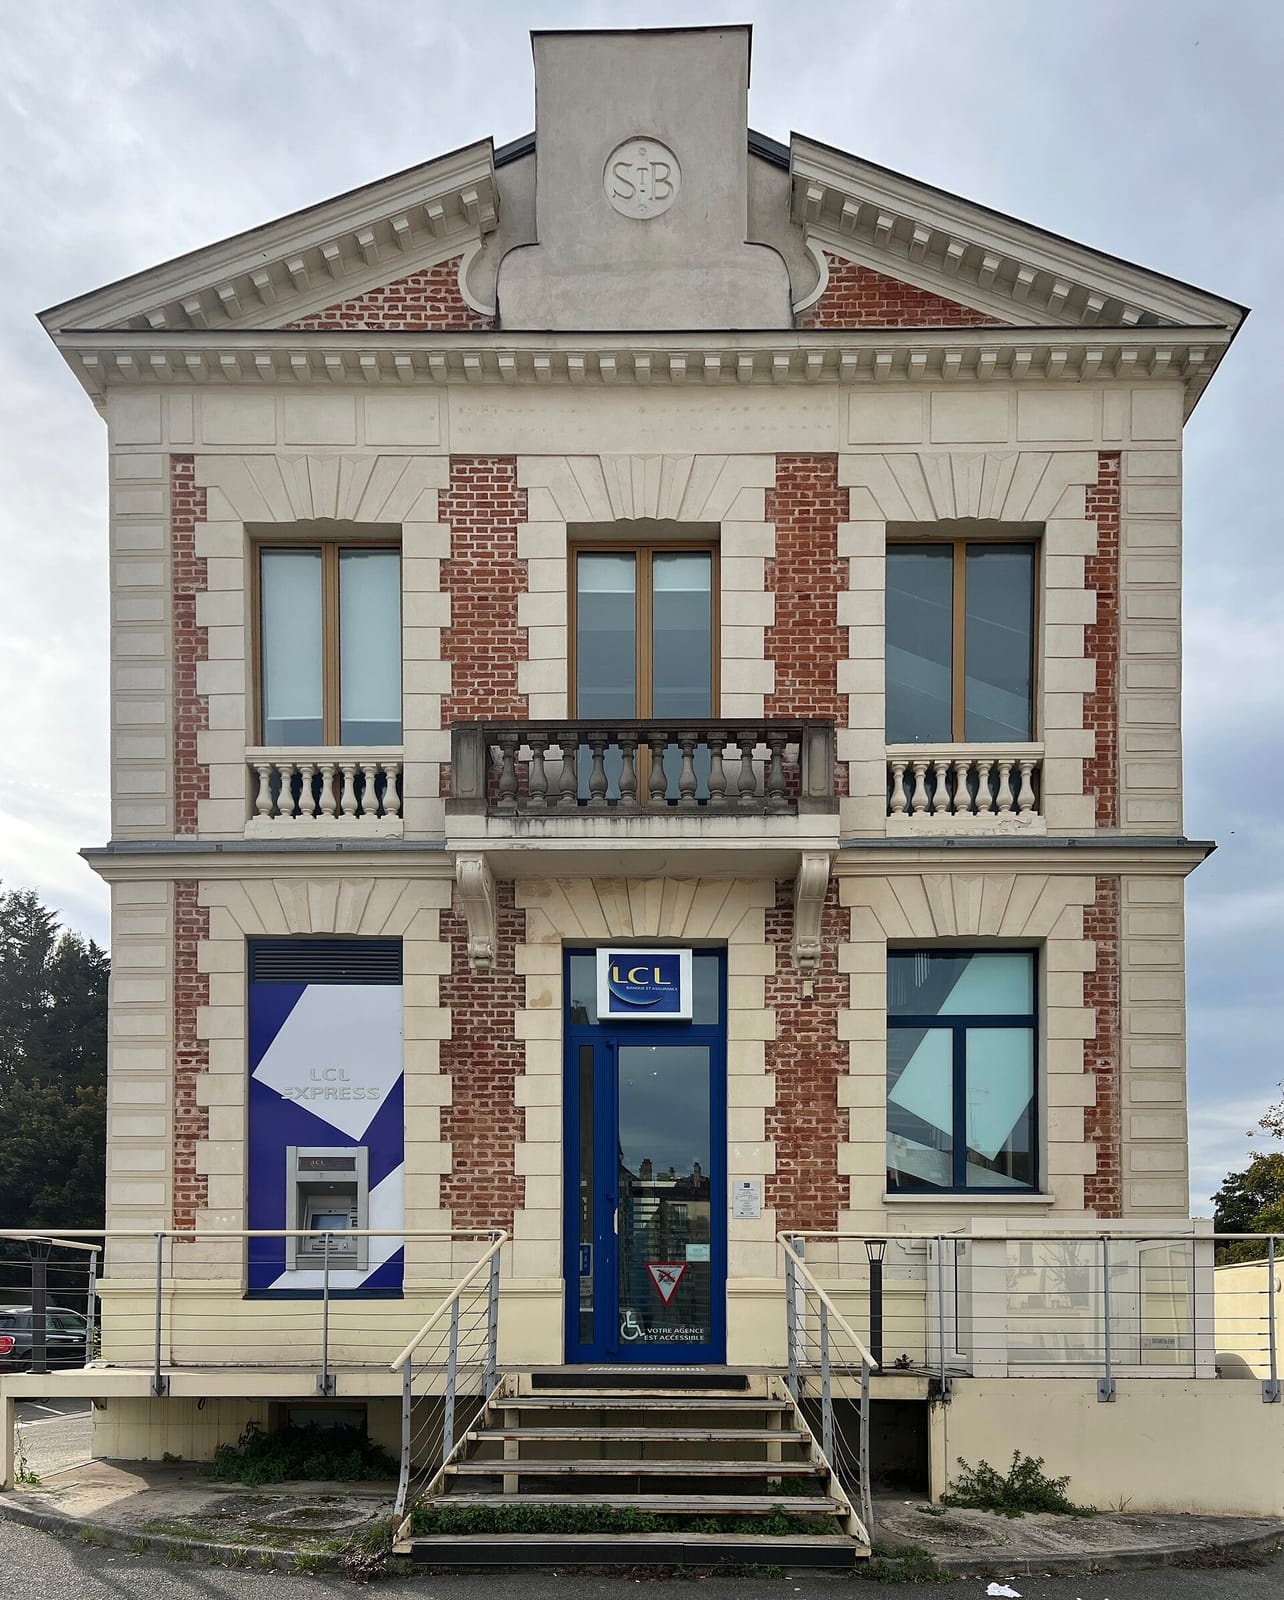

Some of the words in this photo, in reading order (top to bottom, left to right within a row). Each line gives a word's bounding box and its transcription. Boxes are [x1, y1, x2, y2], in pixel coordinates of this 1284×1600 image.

[612, 966, 671, 985] LCL
[310, 1068, 351, 1081] LCL
[281, 1087, 380, 1100] EXPRESS
